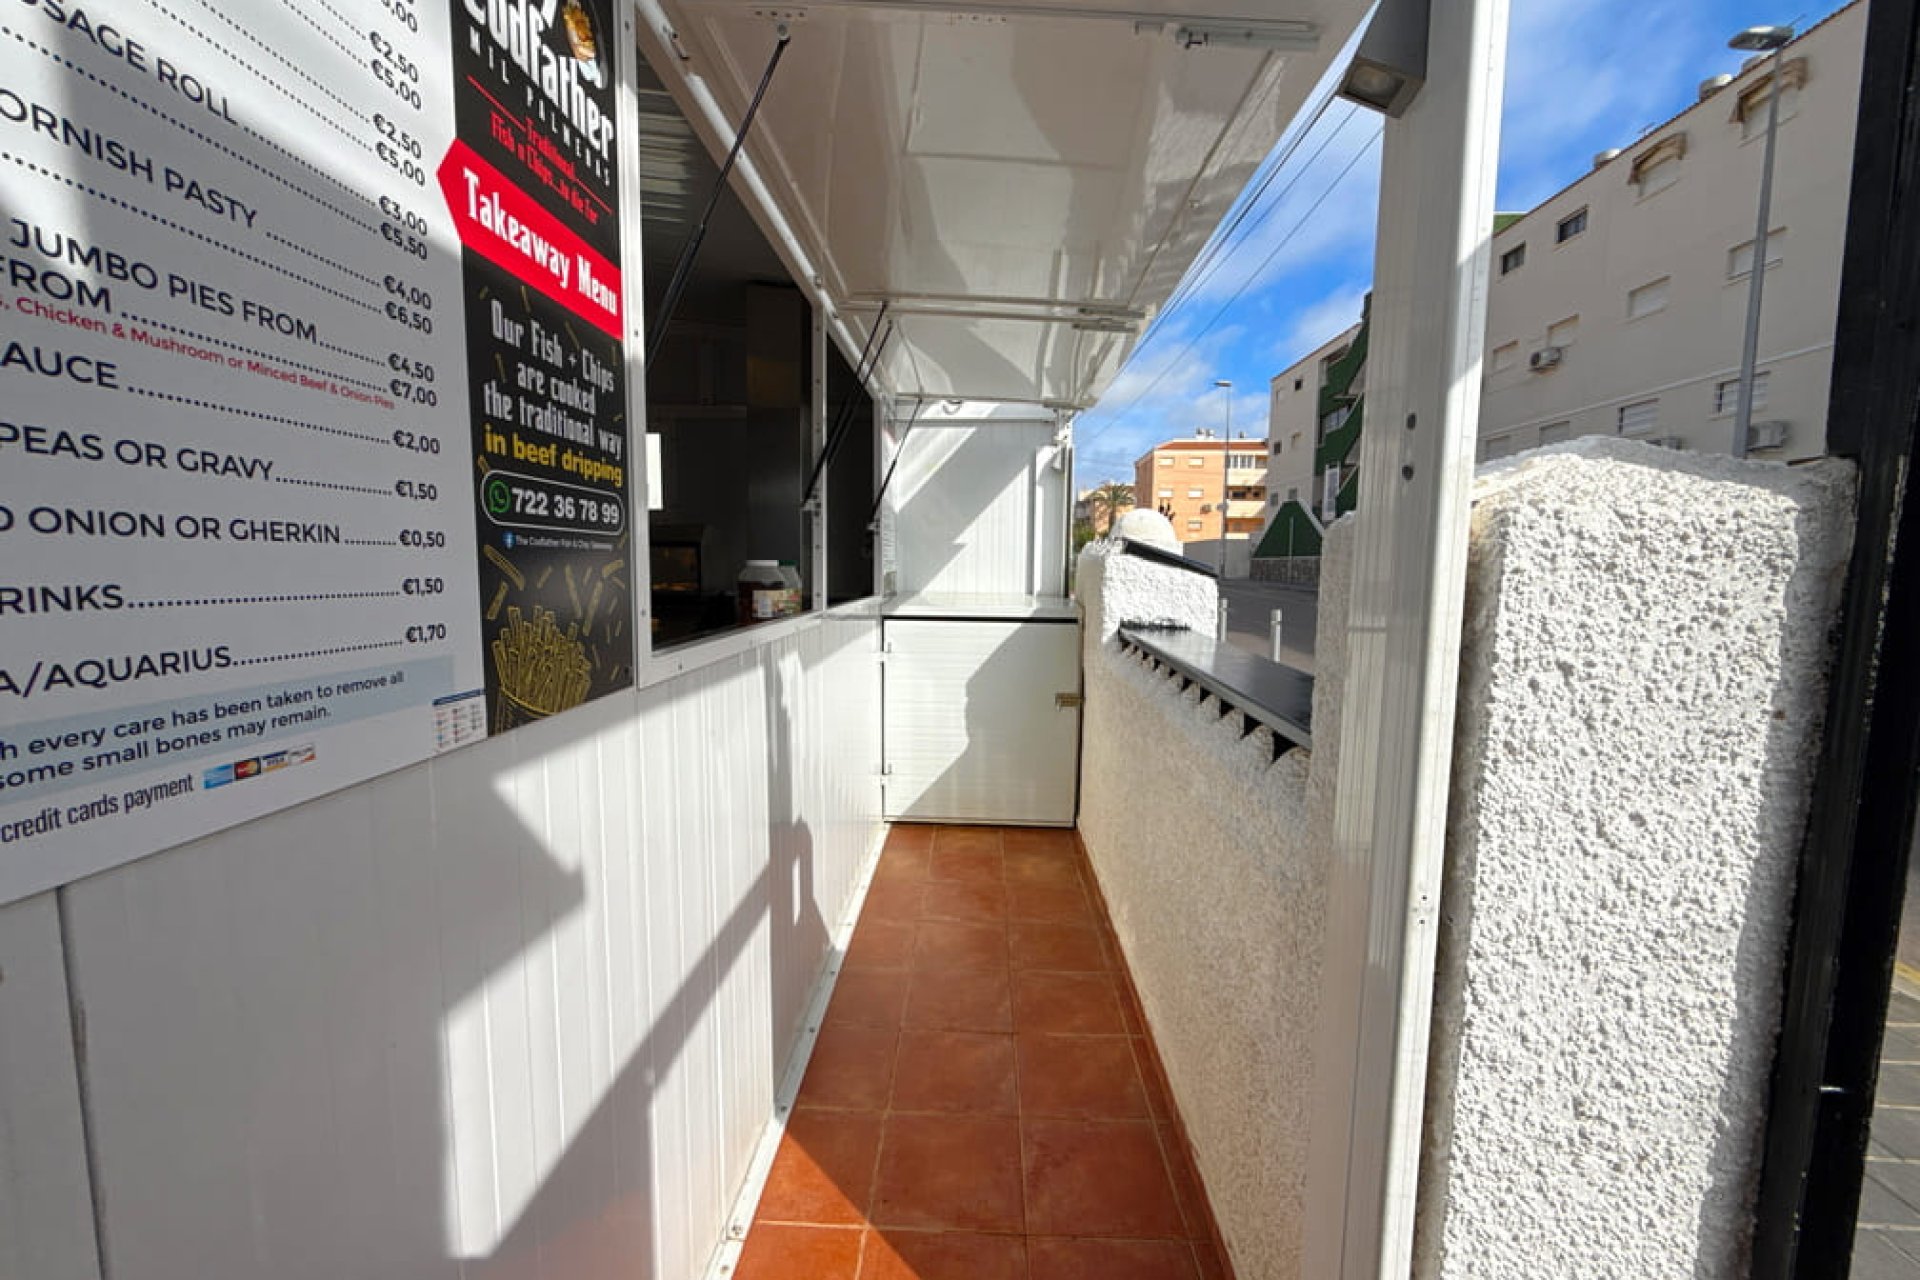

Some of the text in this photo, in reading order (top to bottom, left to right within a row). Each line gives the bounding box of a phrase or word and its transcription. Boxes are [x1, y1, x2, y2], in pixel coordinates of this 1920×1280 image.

[22, 0, 147, 73] SAGE
[156, 56, 238, 126] ROLL
[0, 88, 153, 183] ORNISH
[165, 166, 258, 228] PASTY
[463, 166, 570, 289] Takeaway
[576, 254, 618, 318] Menu
[9, 217, 435, 382] JUMBO PIES FROM €4,50
[385, 301, 432, 334] €6,50
[16, 296, 108, 335] Chicken
[111, 323, 126, 338] &
[130, 327, 225, 365] Mushroom
[228, 355, 244, 369] or
[247, 359, 298, 384] Minced
[299, 373, 327, 390] Beef
[491, 299, 524, 348] Our
[530, 319, 563, 368] Fish
[582, 348, 615, 393] Chips
[0, 341, 441, 454] AUCE €2,00
[390, 379, 437, 407] €7,00
[484, 379, 623, 462] the traditional way
[517, 362, 597, 416] are cooked
[114, 439, 168, 469] OR
[176, 448, 274, 481] GRAVY
[395, 479, 437, 500] €1,50
[484, 422, 624, 489] in beef dripping
[28, 506, 165, 538] ONION
[175, 515, 221, 540] OR
[229, 518, 340, 544] GHERKIN
[400, 529, 445, 550] €0,50
[511, 487, 621, 525] 722 36 78 99
[0, 577, 443, 615] RINKS €1,50
[406, 623, 446, 643] €1,70
[28, 726, 106, 756] every
[113, 716, 166, 738] care
[171, 707, 209, 728] has
[214, 700, 261, 720] been
[266, 688, 313, 711] taken
[317, 682, 333, 699] to
[336, 673, 388, 697] remove
[81, 739, 150, 771] small
[156, 727, 222, 756] bones
[227, 718, 267, 738] may
[271, 703, 333, 729] remain.
[1, 806, 63, 843] credit
[67, 793, 120, 826] cards
[123, 772, 195, 815] payment
